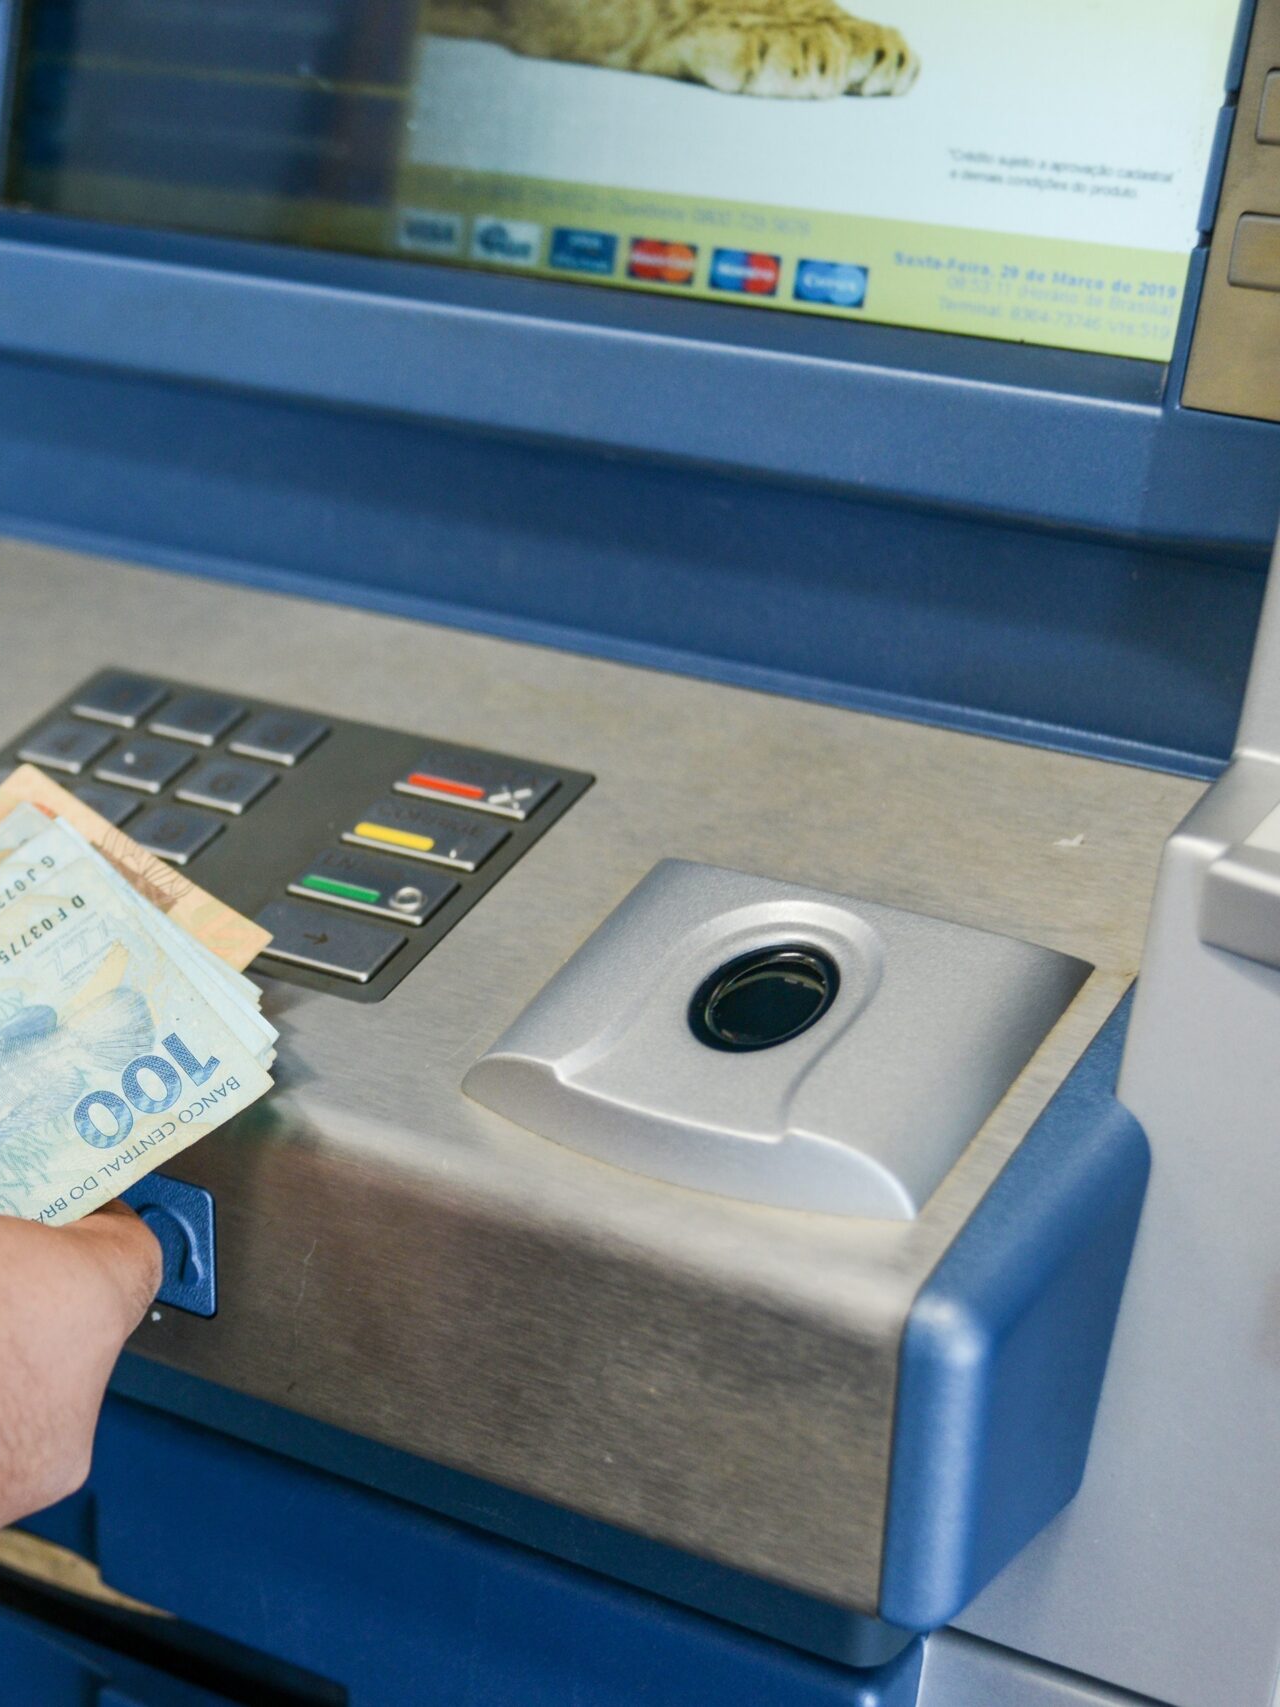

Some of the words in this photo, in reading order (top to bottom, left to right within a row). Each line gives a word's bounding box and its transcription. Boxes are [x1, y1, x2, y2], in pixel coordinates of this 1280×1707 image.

[73, 1032, 221, 1149] 100
[178, 1076, 241, 1124] BANCO
[98, 1121, 176, 1177] CENTRAL
[31, 1197, 68, 1224] BRA
[70, 1176, 99, 1200] DO
